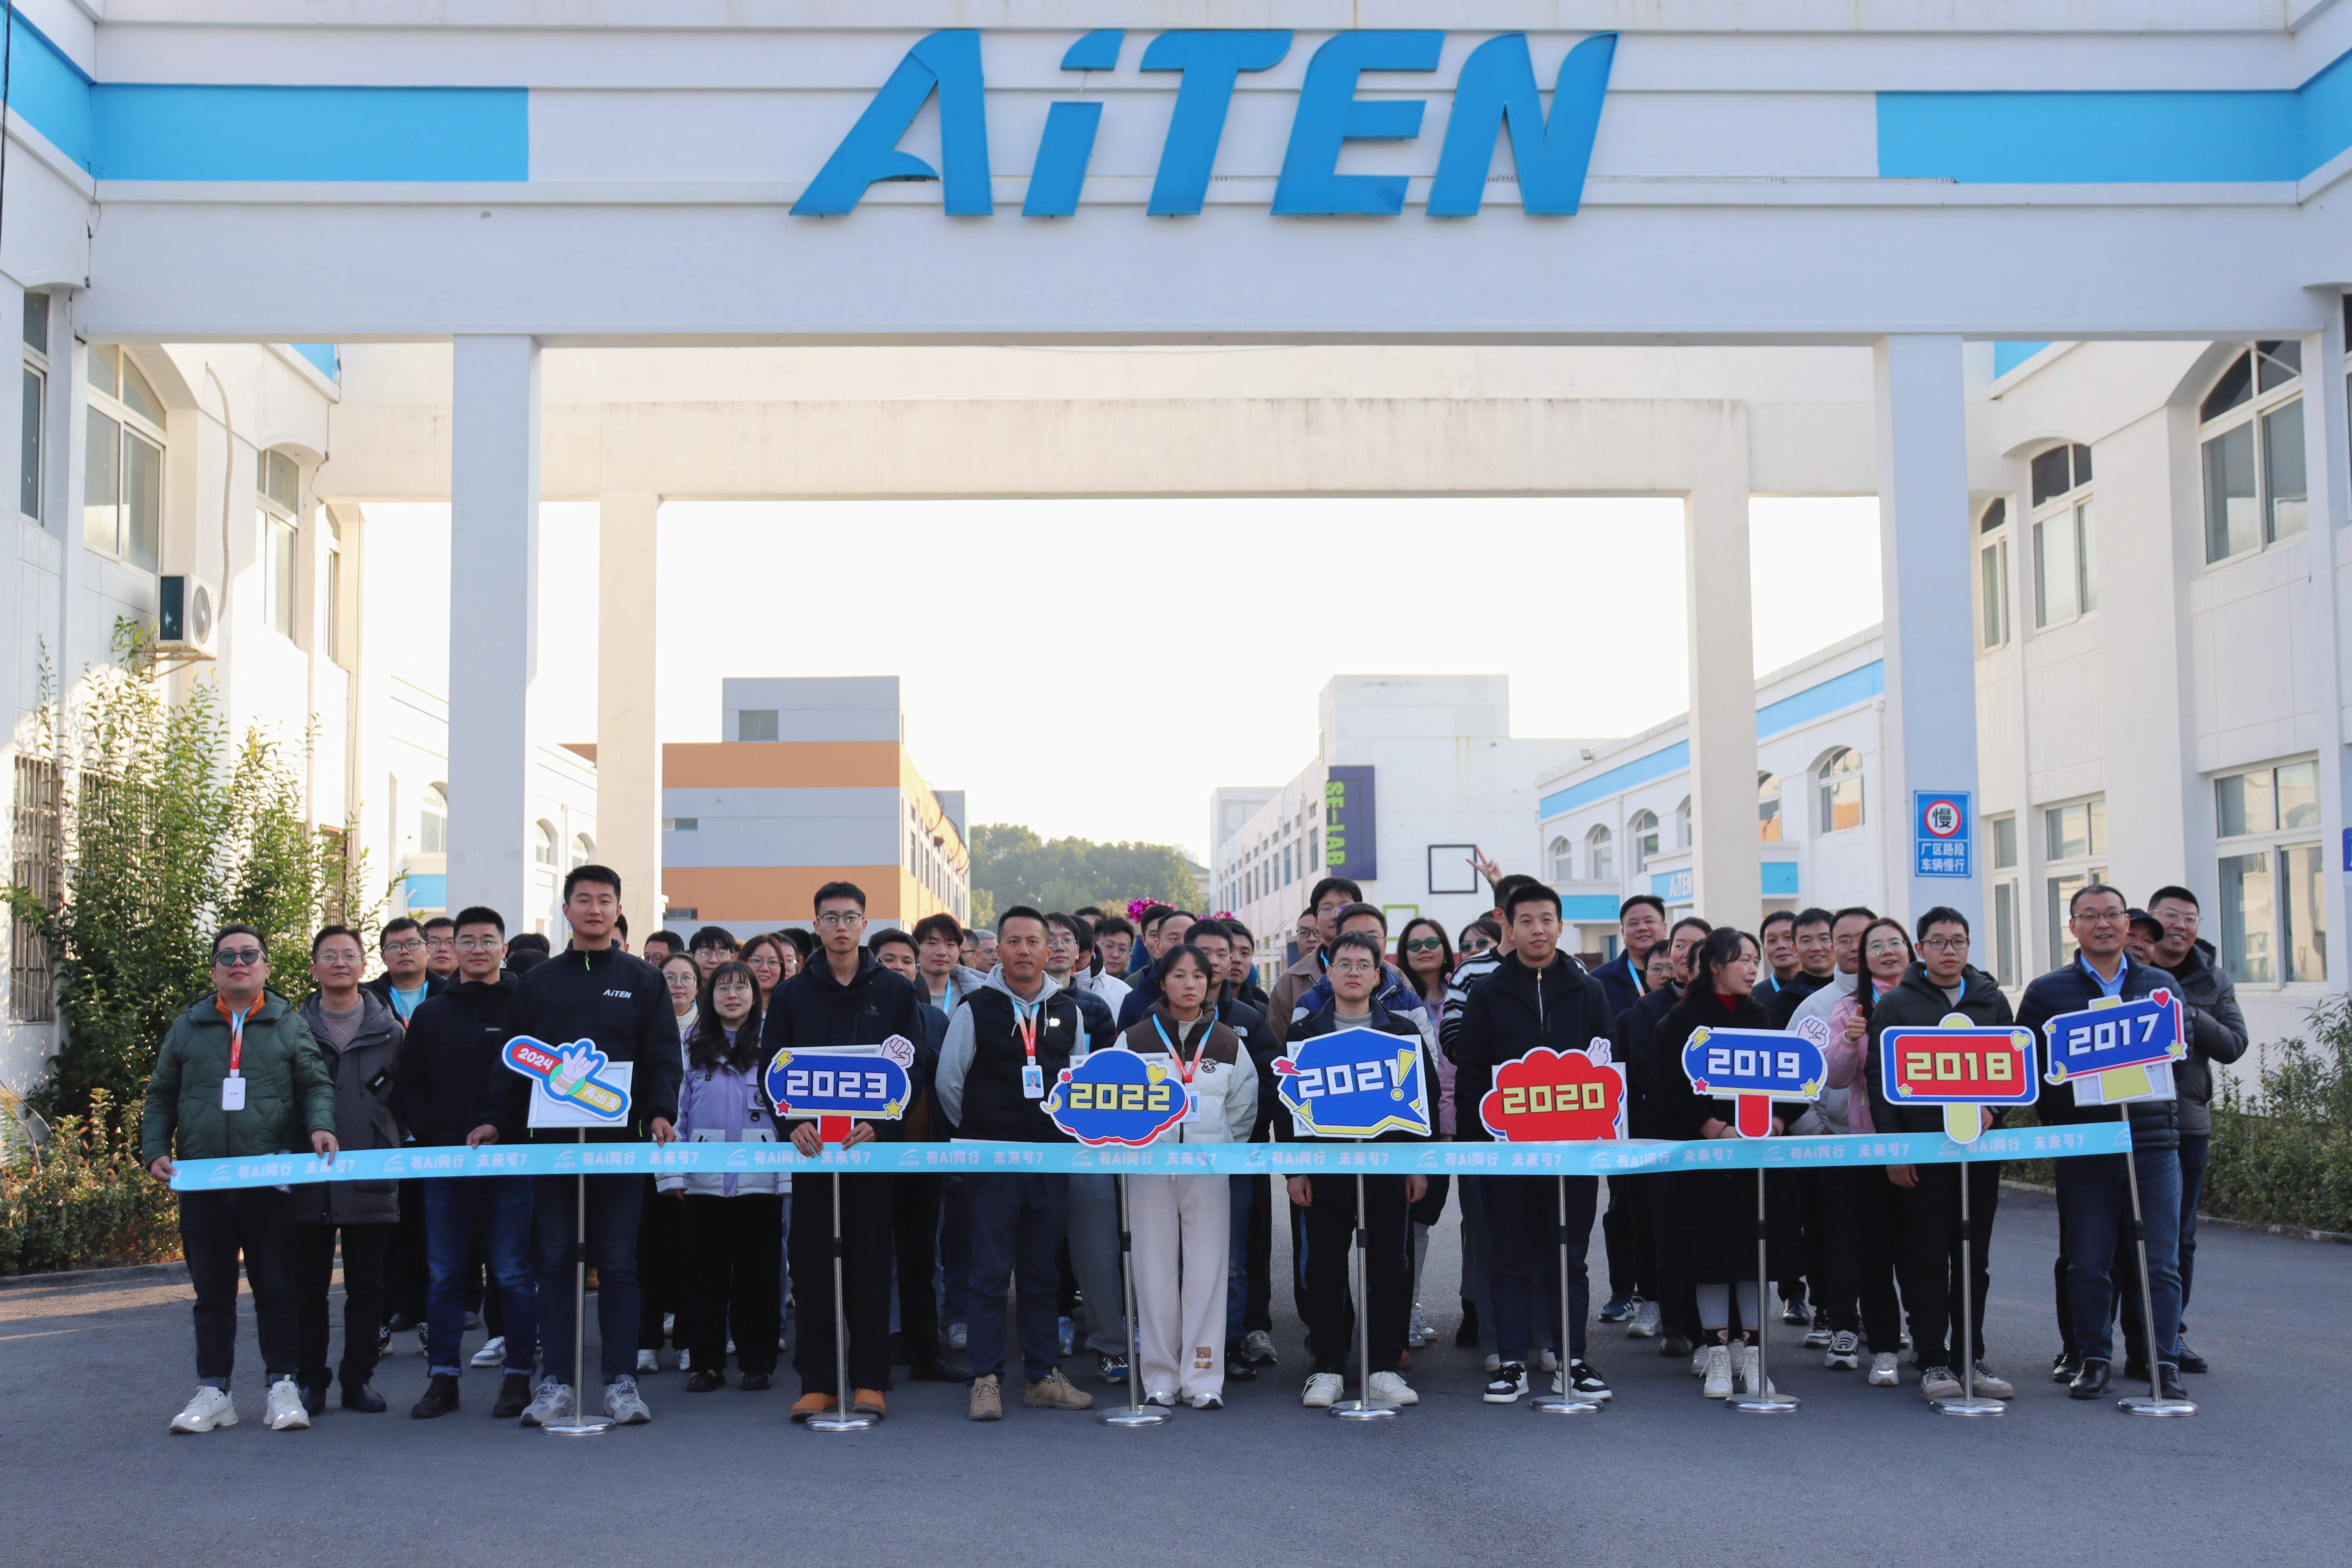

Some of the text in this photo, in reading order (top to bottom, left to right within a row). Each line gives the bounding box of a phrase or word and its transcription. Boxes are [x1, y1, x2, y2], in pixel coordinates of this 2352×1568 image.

[789, 28, 1619, 216] AiTEN
[1325, 781, 1345, 865] SE-LAB
[1932, 808, 1952, 828] 慢
[1921, 842, 1965, 856] 厂区路段
[1921, 858, 1965, 872] 车辆慢行
[603, 989, 632, 998] AiTEN
[2067, 1013, 2160, 1056] 2017
[518, 1048, 554, 1070] 2024
[1707, 1047, 1800, 1078] 2019
[1905, 1052, 2013, 1080] 2018
[786, 1069, 887, 1099] 2023
[583, 1085, 621, 1110] 再出发
[1067, 1082, 1171, 1111] 2022
[1502, 1082, 1606, 1114] 2020
[2033, 1134, 2083, 1150] 未来可7
[649, 1151, 699, 1165] 未来可7
[821, 1150, 871, 1165] 未来可7
[994, 1151, 1044, 1165] 未来可7
[1684, 1148, 1734, 1162] 未来可7
[1858, 1143, 1909, 1158] 未来可7
[477, 1152, 527, 1167] 未来可7
[1167, 1151, 1216, 1166] 未来可7
[1339, 1151, 1389, 1166] 未来可7
[1512, 1152, 1562, 1167] 未来可7
